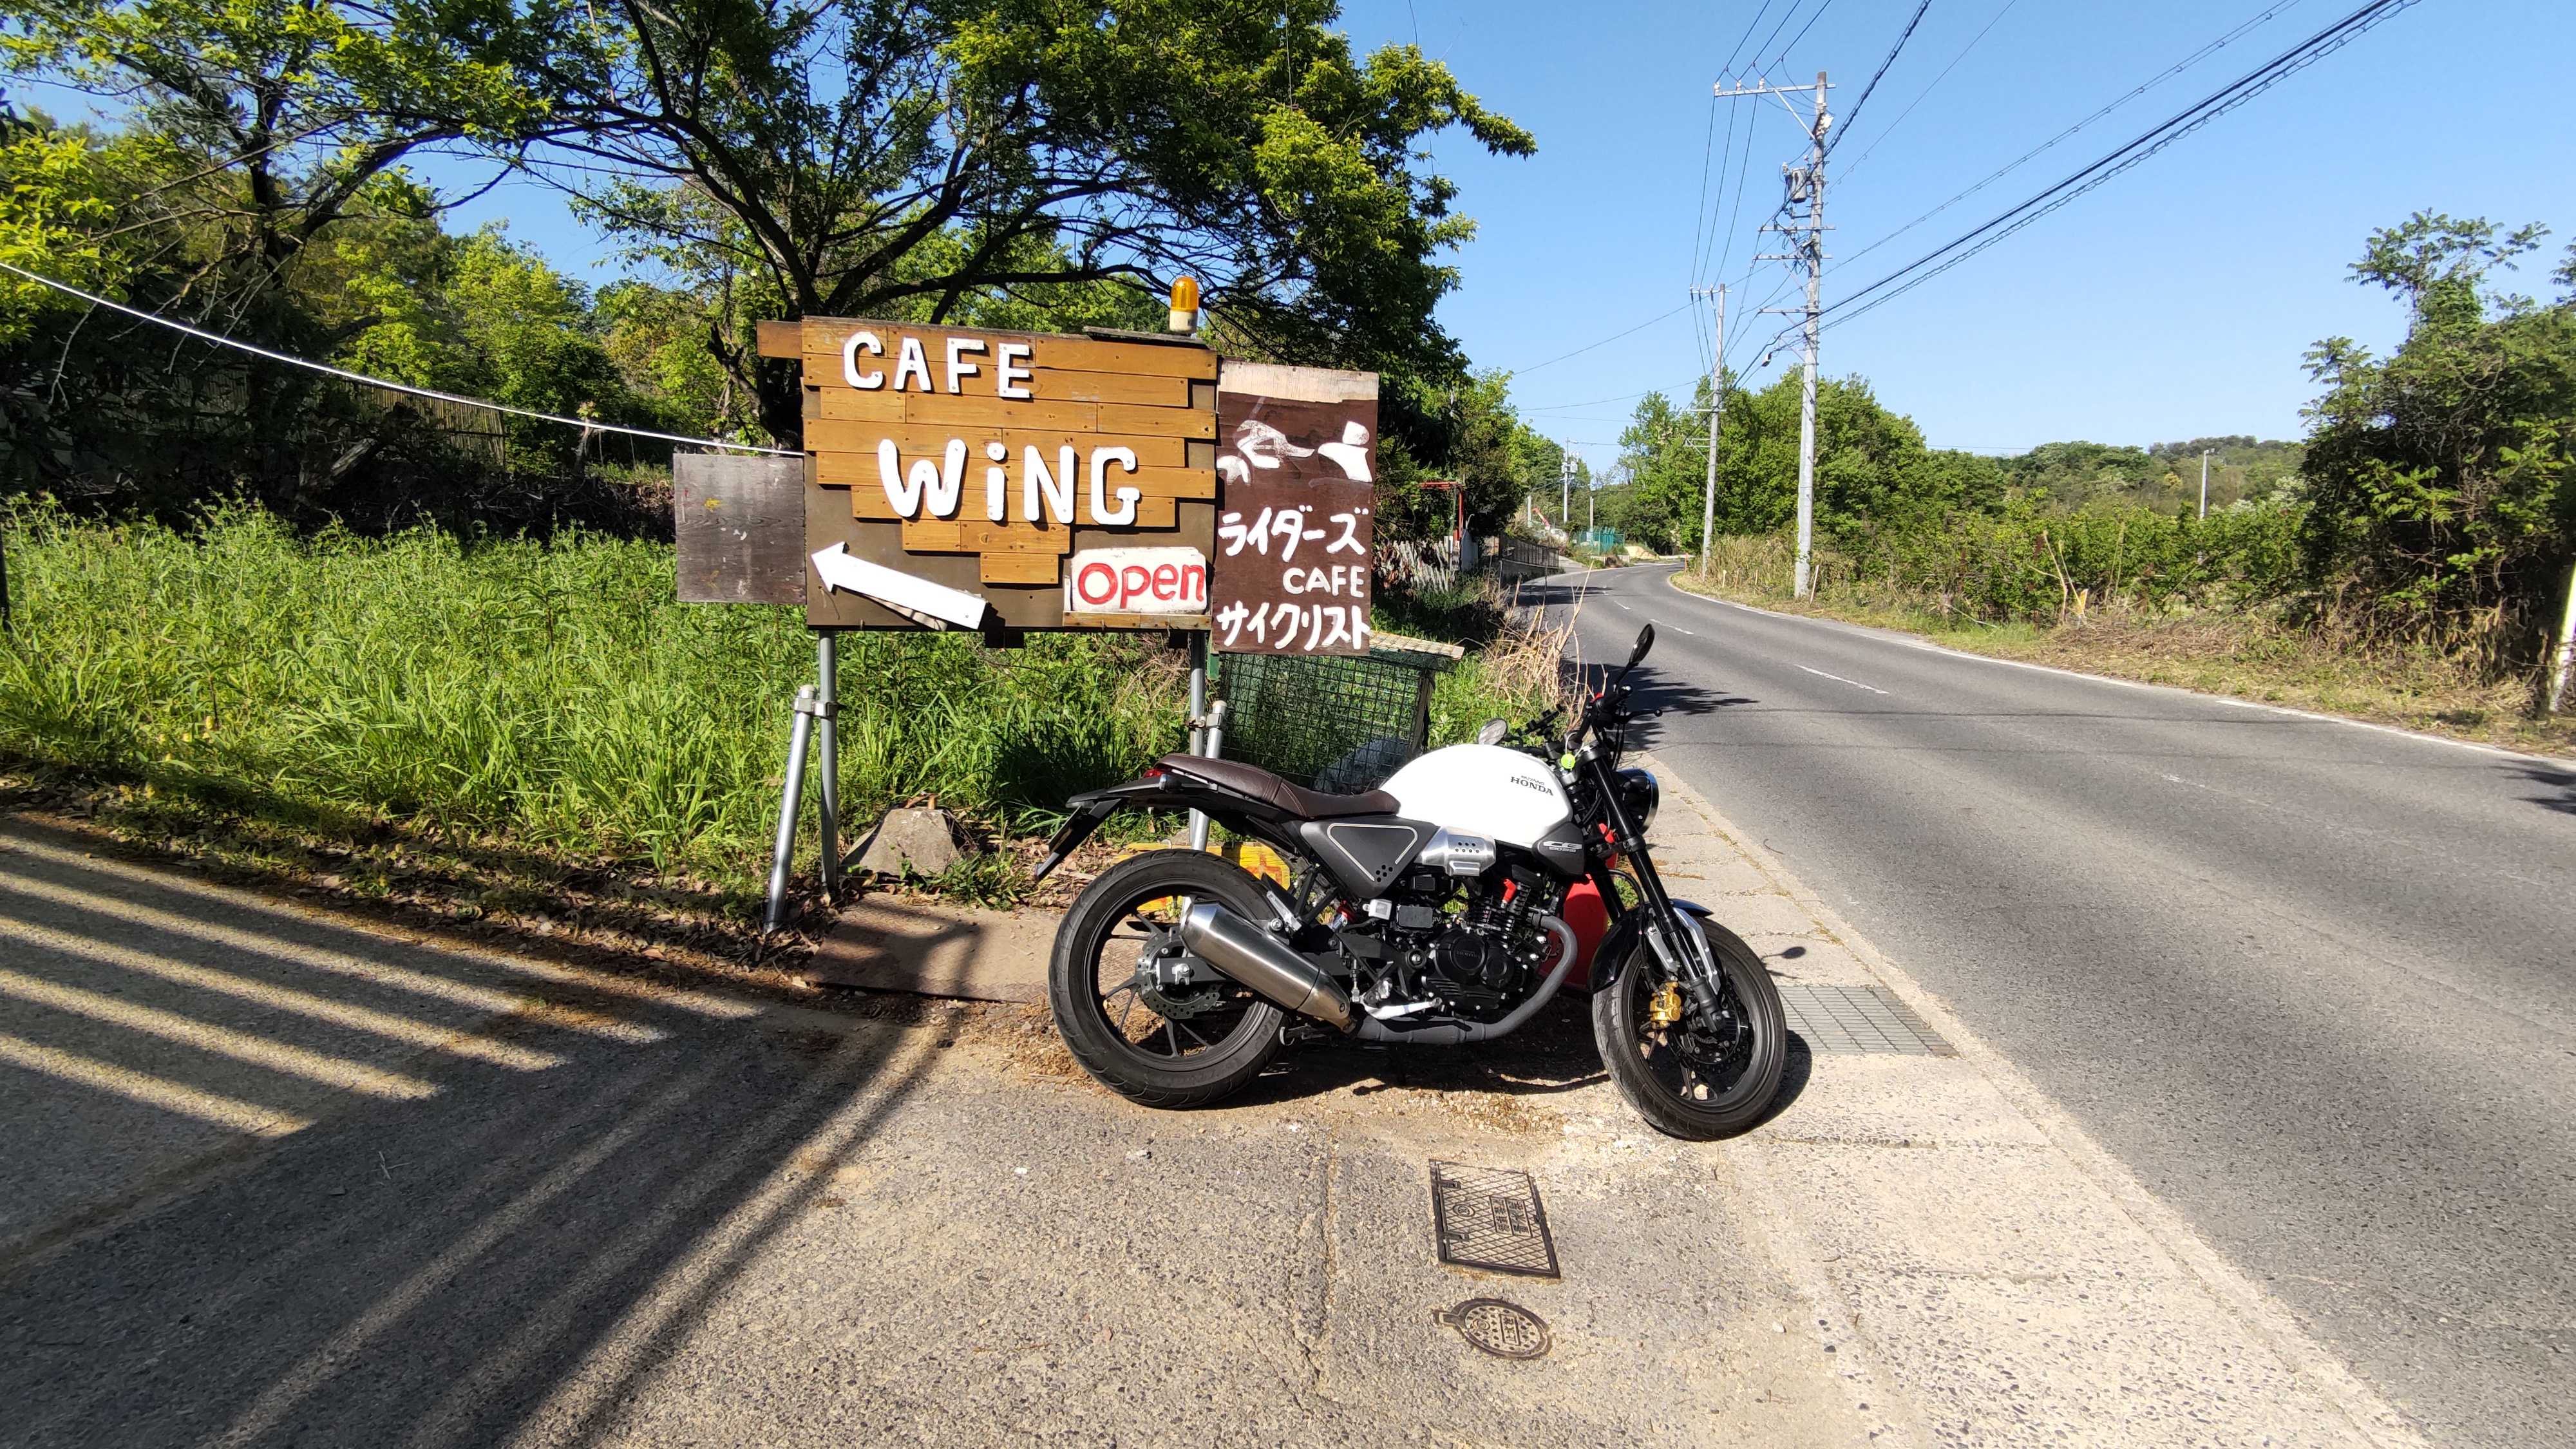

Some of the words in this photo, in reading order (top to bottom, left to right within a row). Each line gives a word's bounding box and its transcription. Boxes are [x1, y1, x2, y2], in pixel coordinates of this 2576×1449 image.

[843, 332, 1032, 399] CAFE
[1218, 505, 1369, 563] ライダーズ
[1282, 565, 1366, 598] CAFE
[1216, 600, 1371, 652] サイクリスト
[1510, 776, 1554, 796] HONDA
